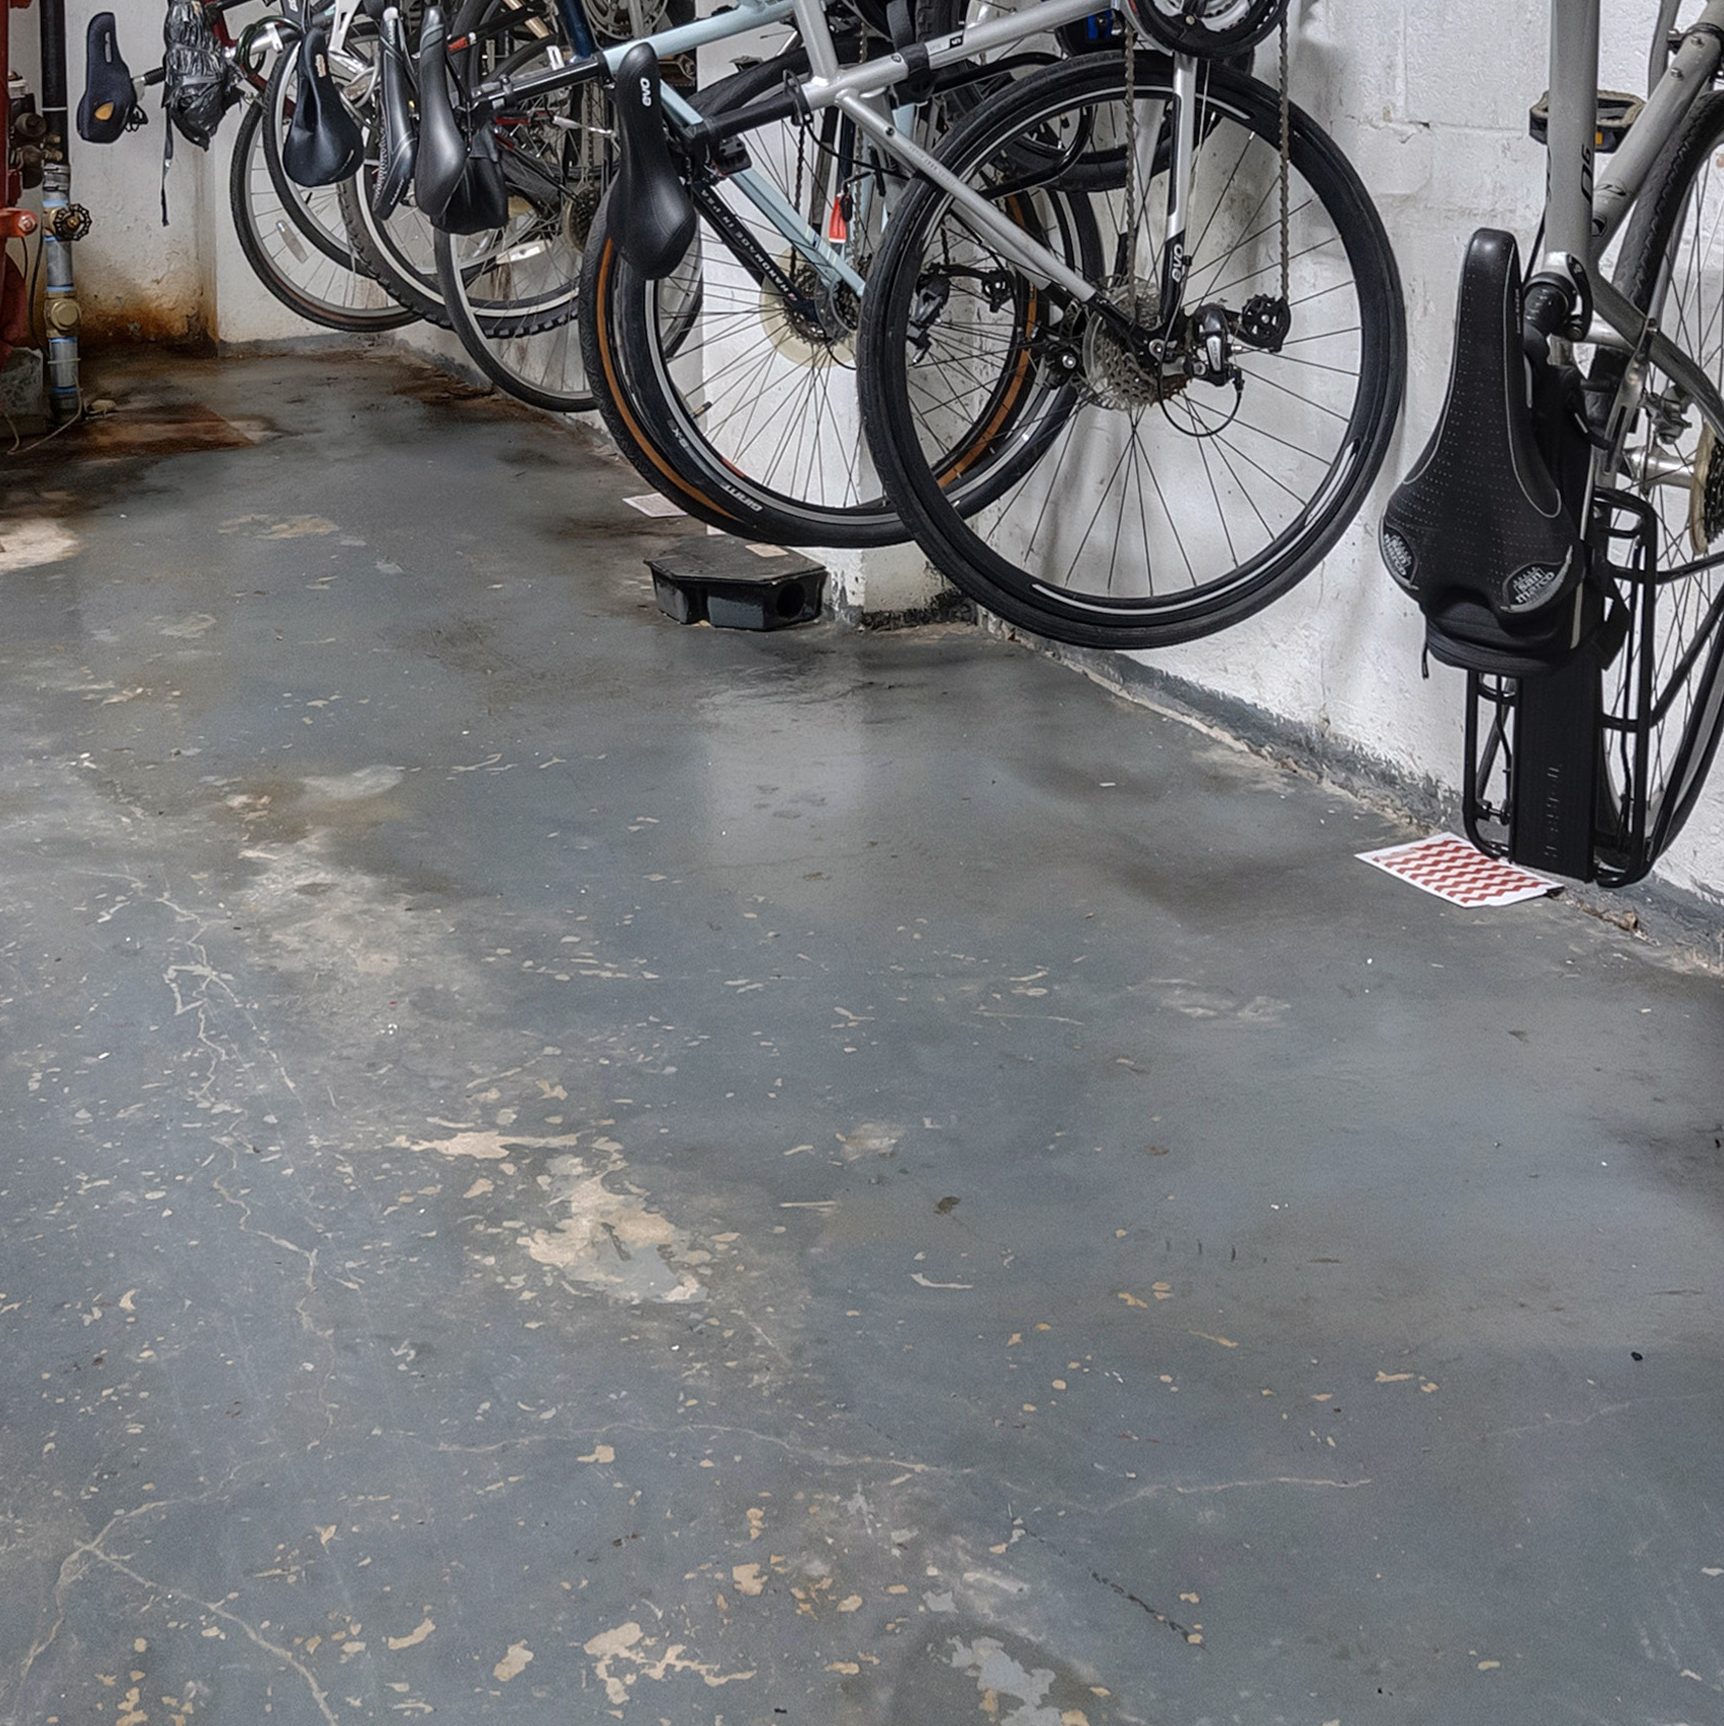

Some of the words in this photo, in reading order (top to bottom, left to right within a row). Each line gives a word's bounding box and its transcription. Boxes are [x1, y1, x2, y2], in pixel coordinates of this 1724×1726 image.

[640, 77, 652, 107] evo
[1172, 242, 1186, 283] evo
[1514, 571, 1555, 604] marco
